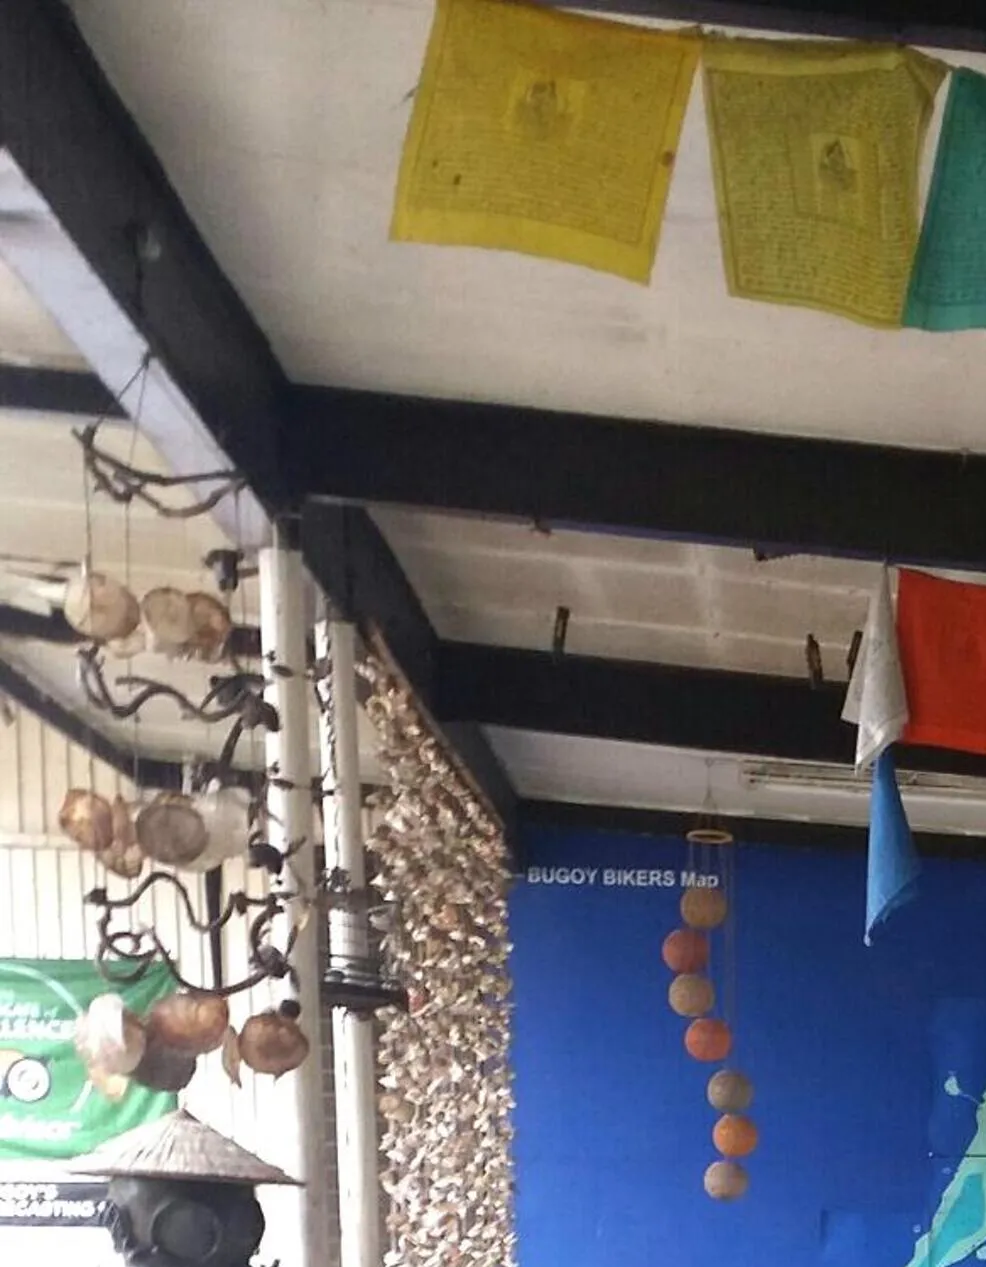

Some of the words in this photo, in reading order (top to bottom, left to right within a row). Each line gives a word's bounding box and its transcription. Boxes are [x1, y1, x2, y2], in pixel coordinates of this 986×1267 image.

[527, 867, 598, 885] BUGOY
[603, 869, 676, 887] BIKERS
[680, 872, 719, 888] Map
